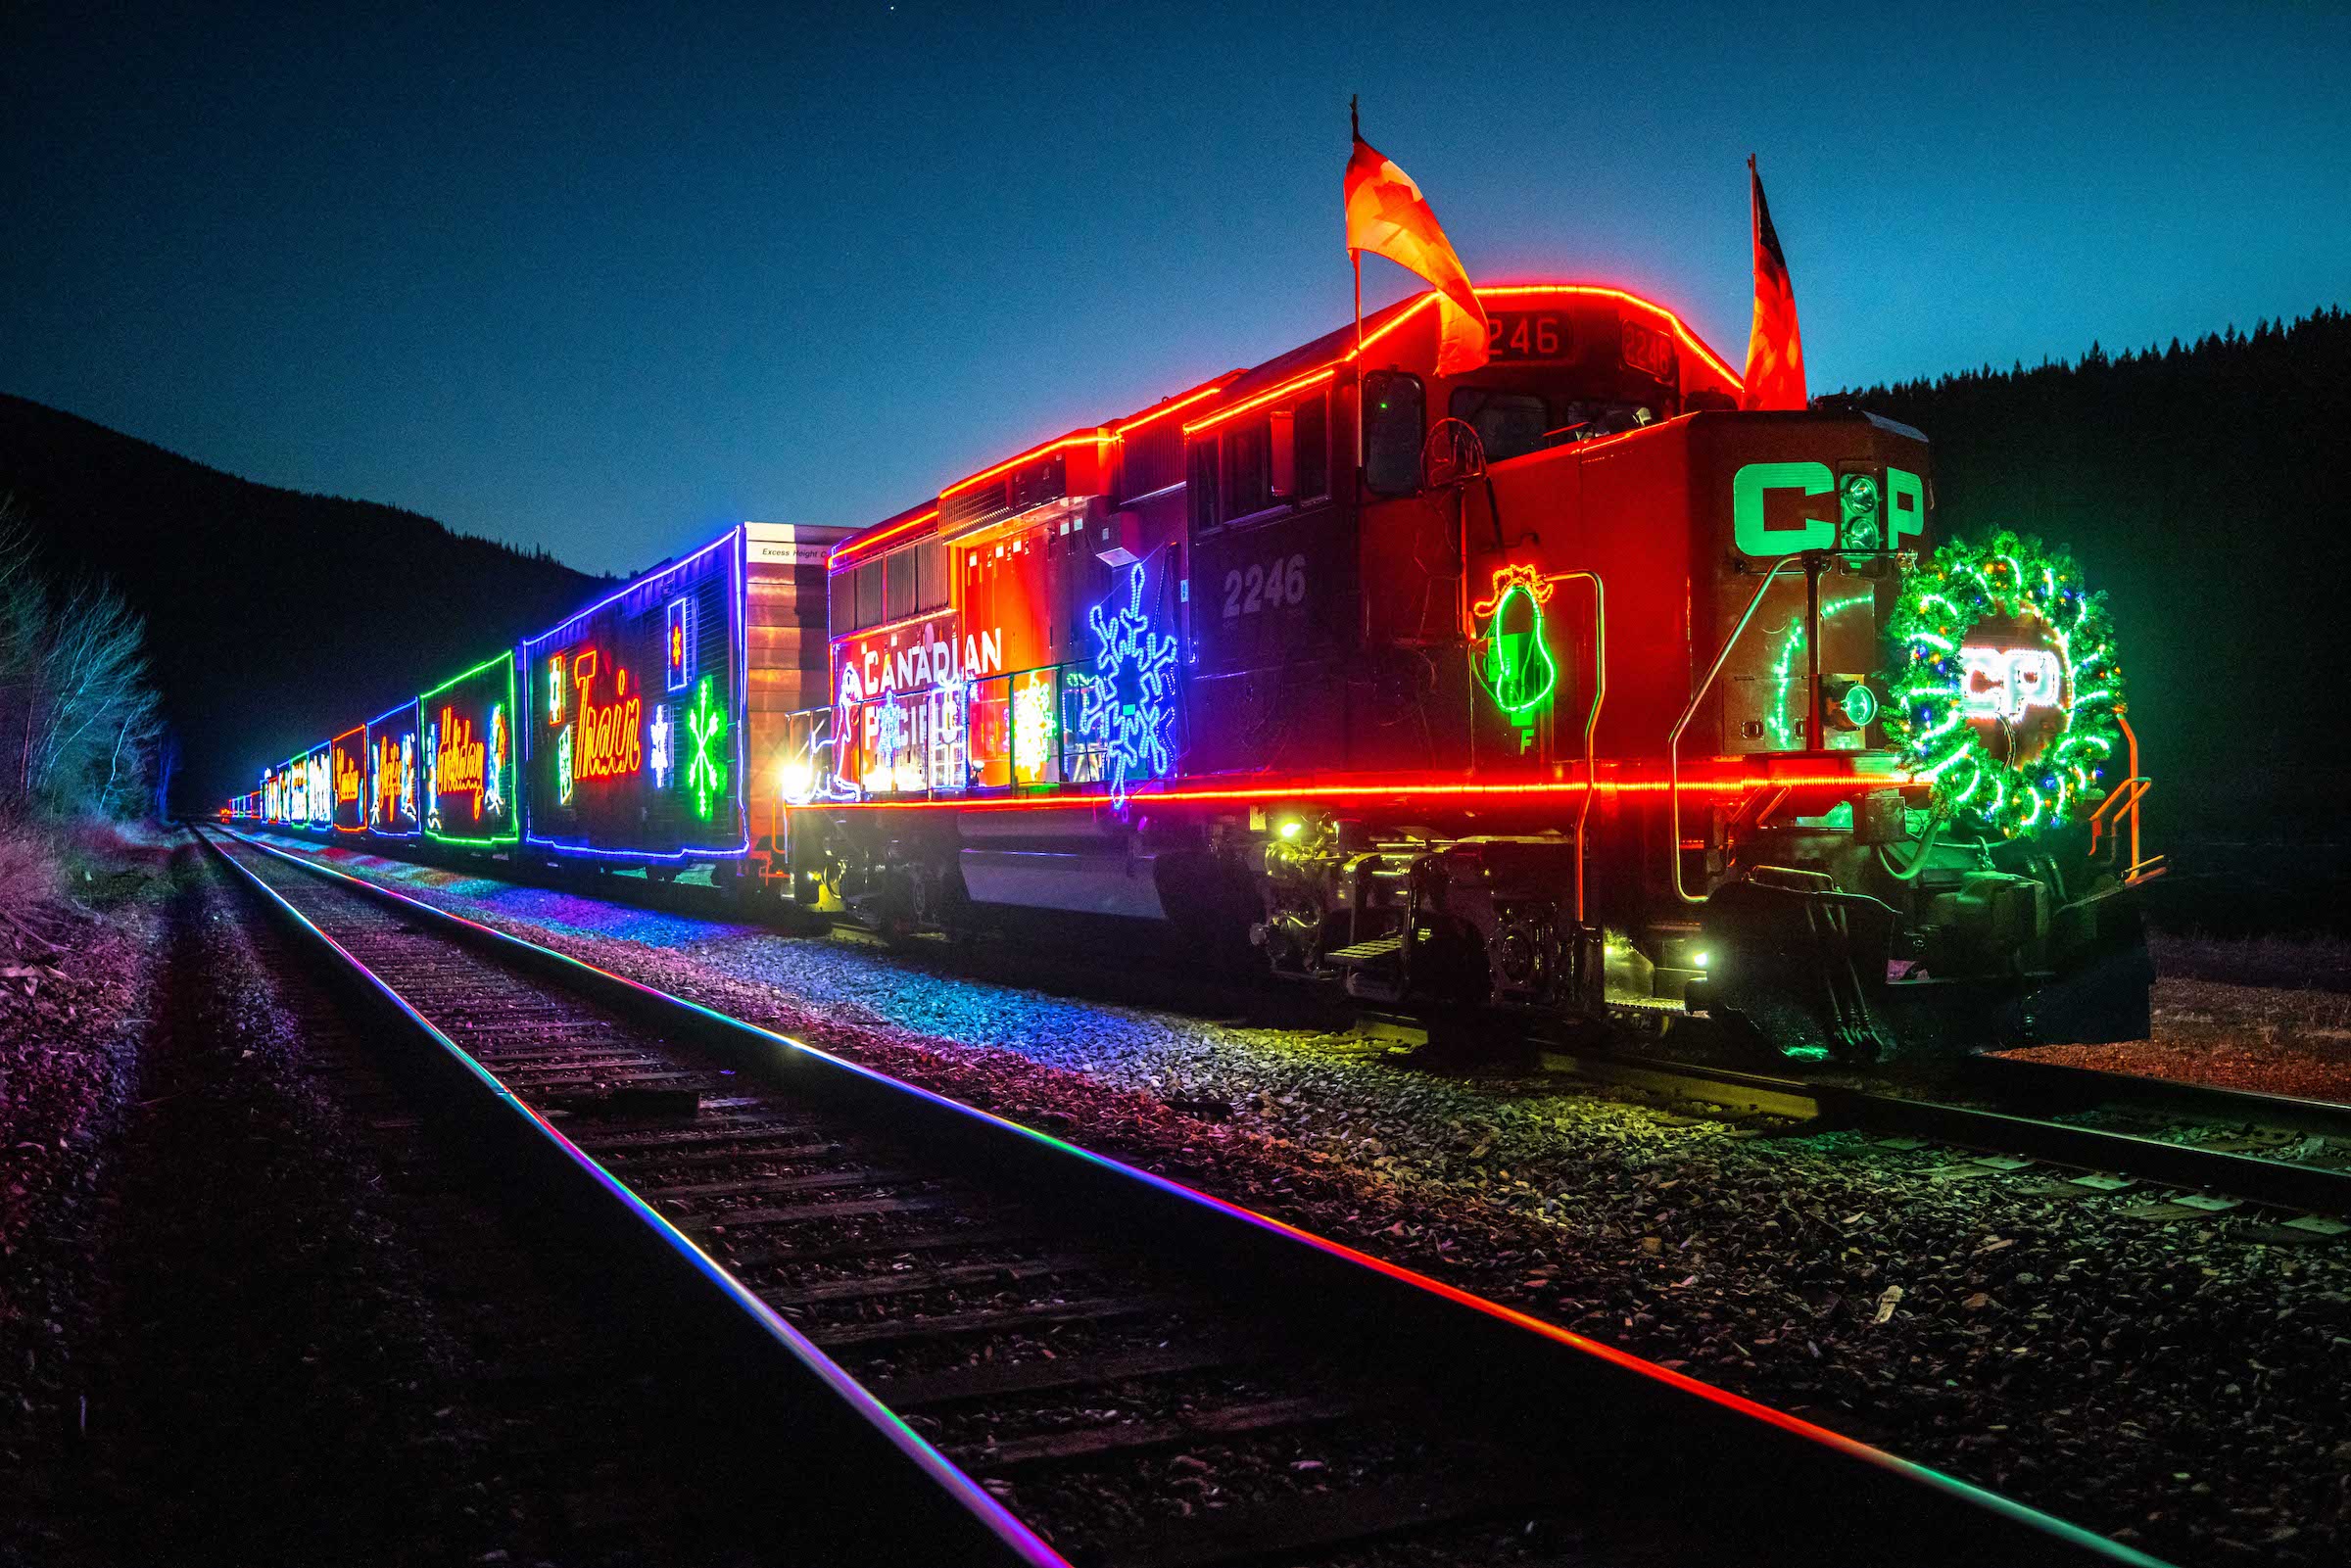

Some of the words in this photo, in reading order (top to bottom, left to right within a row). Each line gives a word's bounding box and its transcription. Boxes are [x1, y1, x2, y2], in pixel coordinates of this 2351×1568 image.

[1487, 316, 1560, 356] 246
[1733, 461, 1925, 556] CP
[1223, 554, 1306, 618] 2246
[864, 627, 1001, 695] CANADIAN
[1959, 646, 2059, 725] CP
[574, 650, 641, 779] Train
[1520, 729, 1535, 755] F
